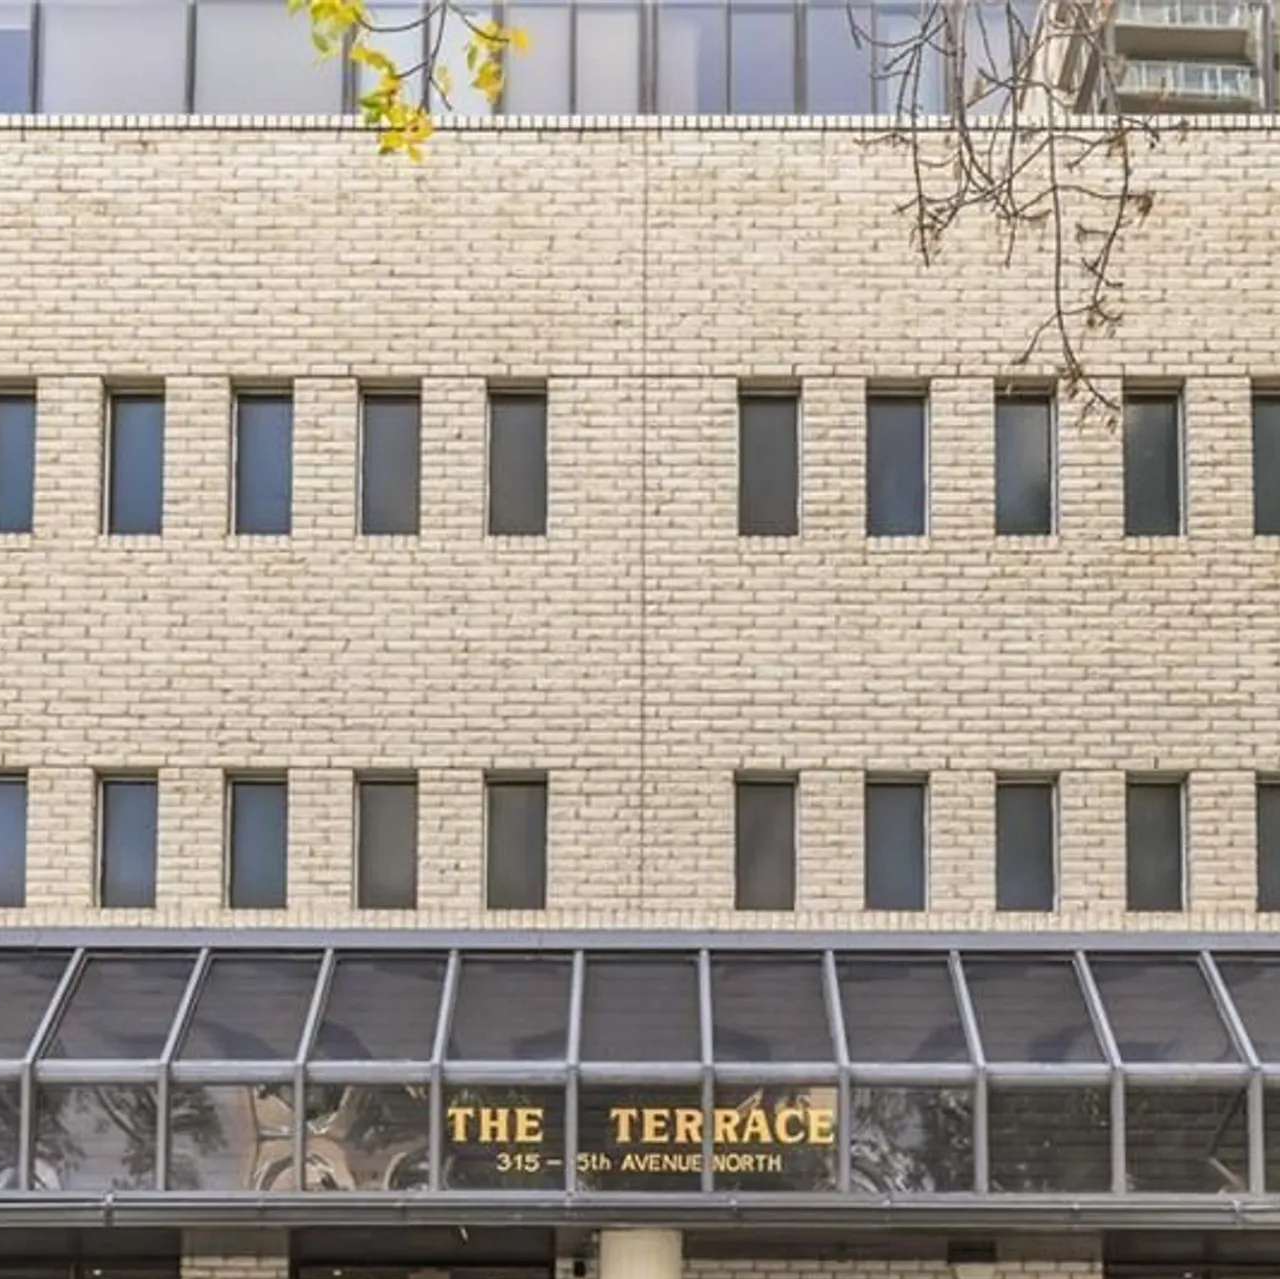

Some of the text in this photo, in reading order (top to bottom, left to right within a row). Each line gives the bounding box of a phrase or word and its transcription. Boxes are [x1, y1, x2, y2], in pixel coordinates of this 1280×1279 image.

[448, 1107, 836, 1144] THE TERRACE
[496, 1152, 540, 1173] 315
[576, 1152, 610, 1172] 5th
[621, 1153, 701, 1172] AVENUE
[712, 1153, 781, 1172] NORTH
